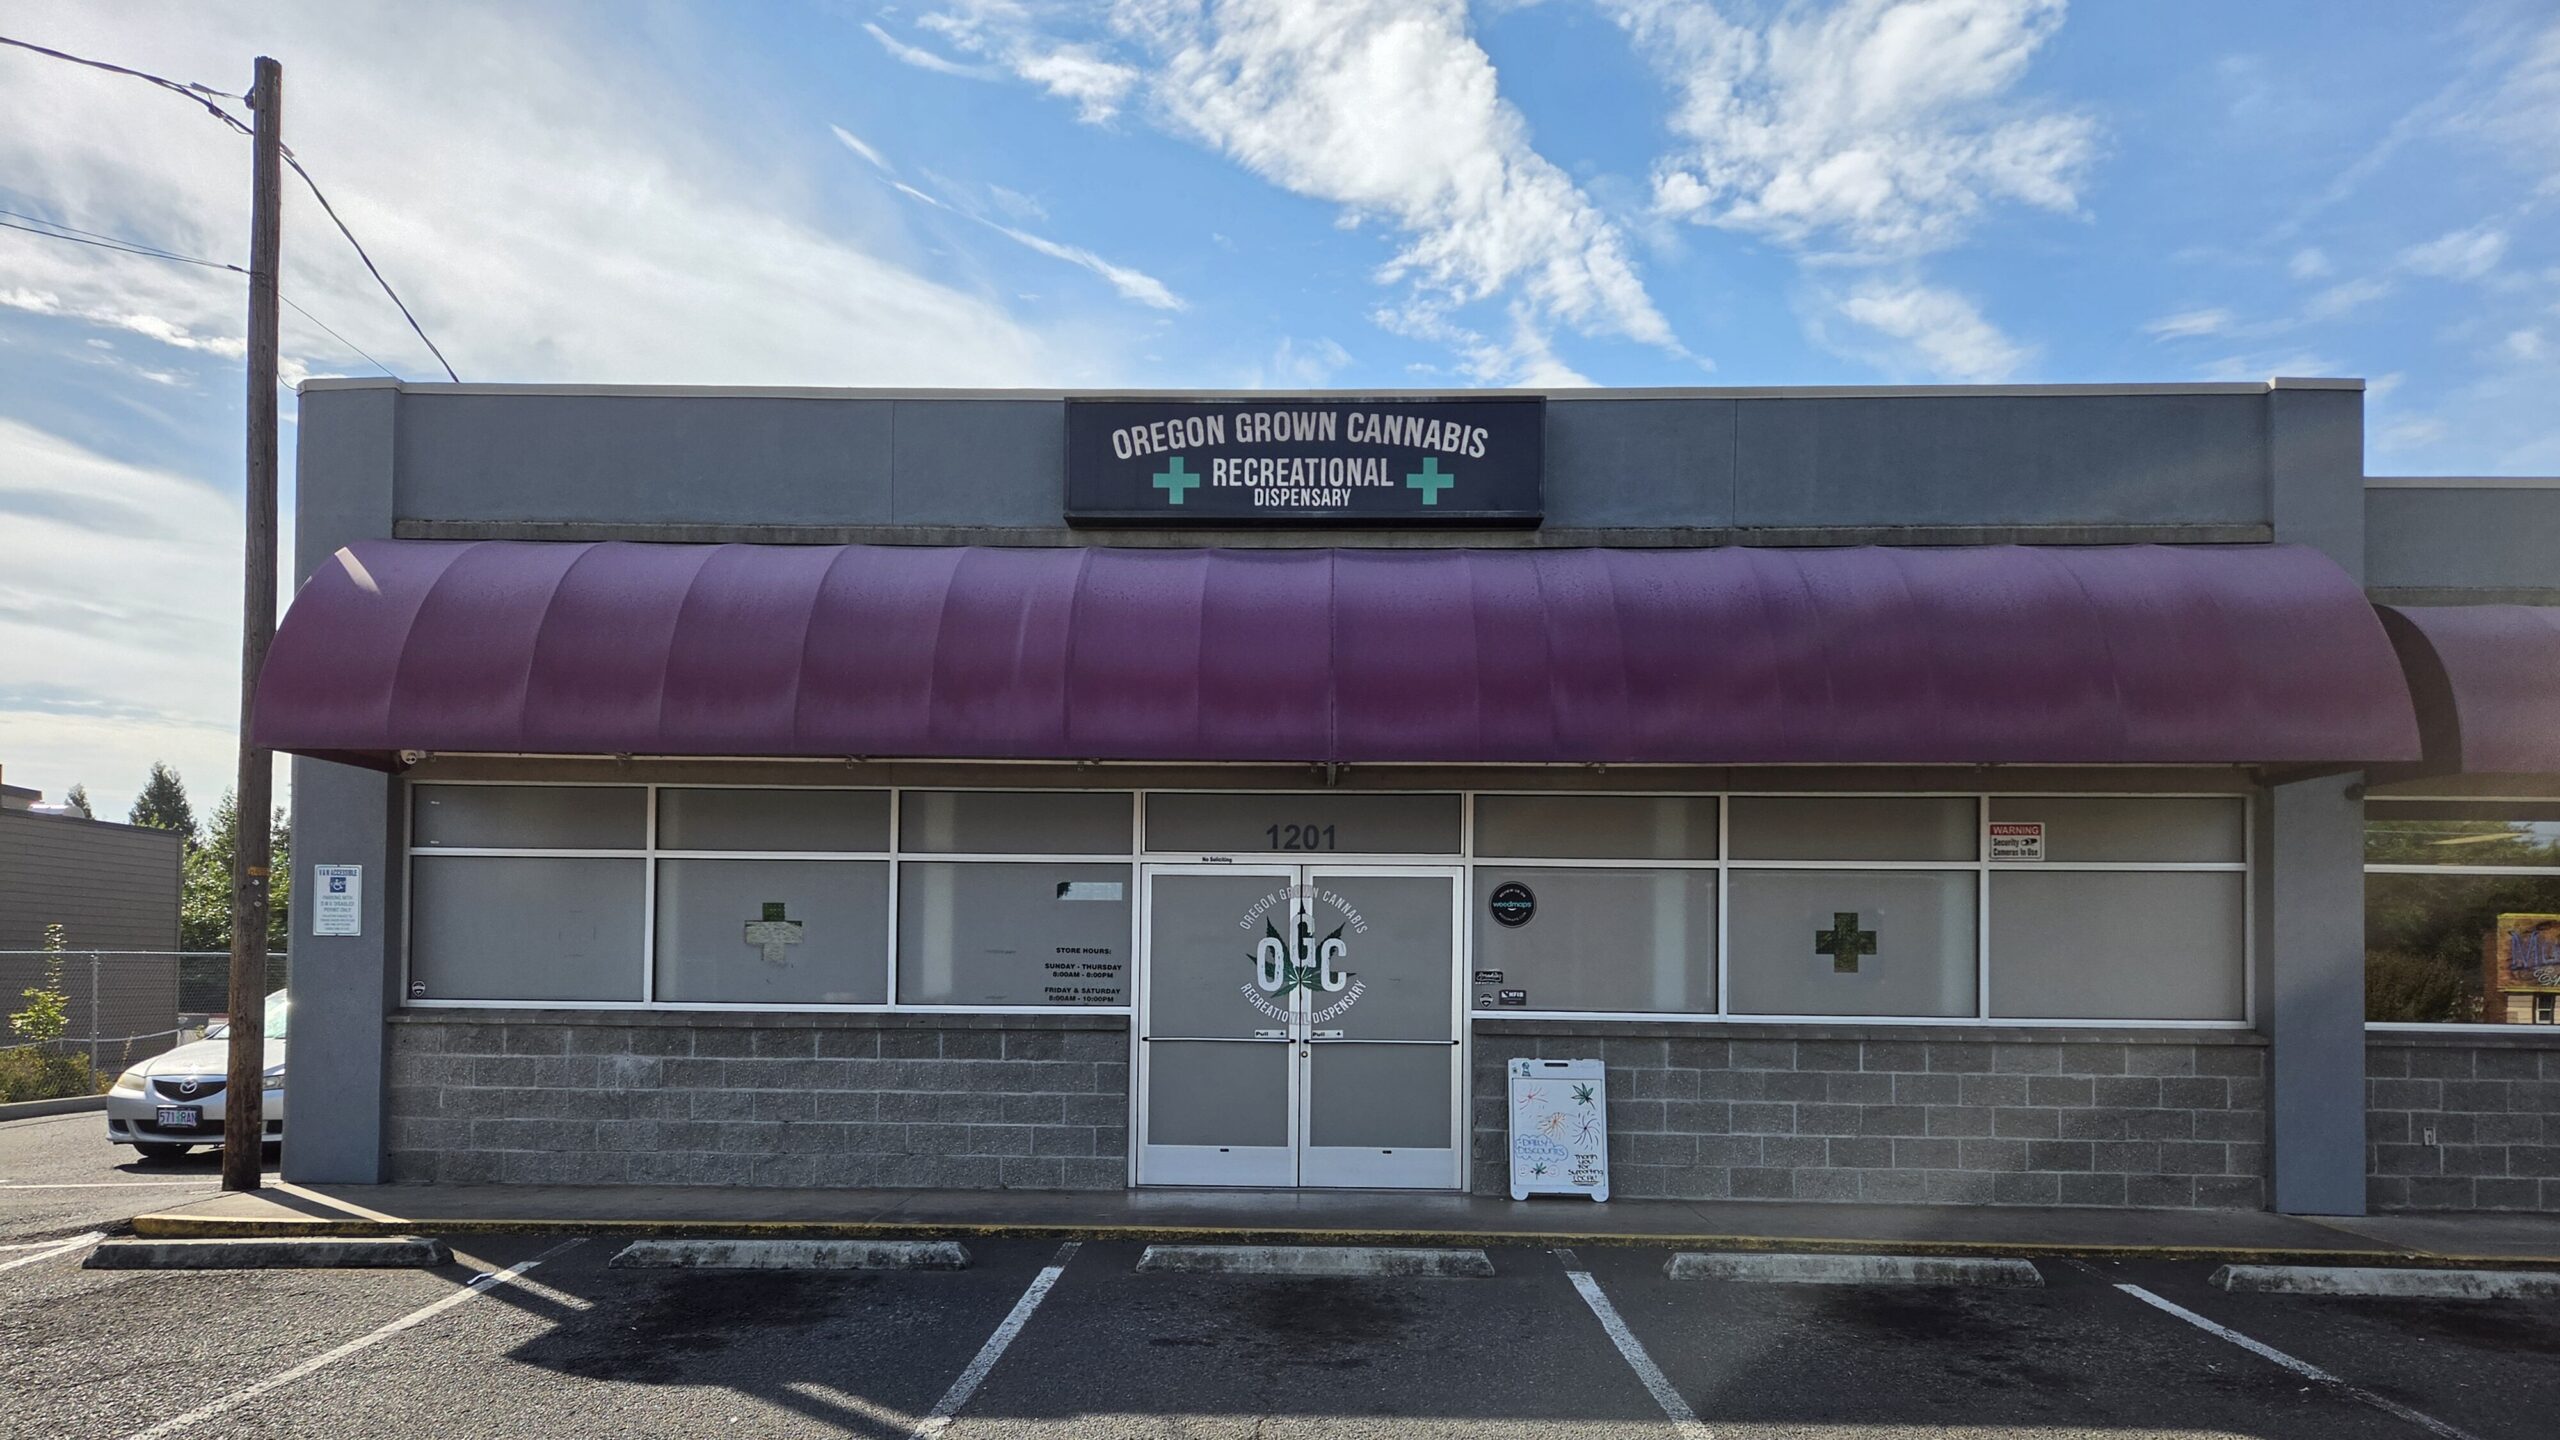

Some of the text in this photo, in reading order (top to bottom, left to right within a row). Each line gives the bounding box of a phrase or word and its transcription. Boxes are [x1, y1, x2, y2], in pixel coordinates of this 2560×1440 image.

[1112, 411, 1488, 460] OREGON GROWN CANNABIS
[1212, 458, 1394, 487] RECREATIONAL
[1254, 488, 1352, 507] DISPENSARY
[1266, 824, 1335, 850] 1201
[1993, 826, 2039, 834] WARNING
[1993, 838, 2019, 847] Security
[1239, 893, 1277, 930] OREGON
[1322, 890, 1368, 934] CANNABIS
[1240, 979, 1367, 1025] RECREATIONAL DISPENSARY
[160, 1111, 175, 1123] 571
